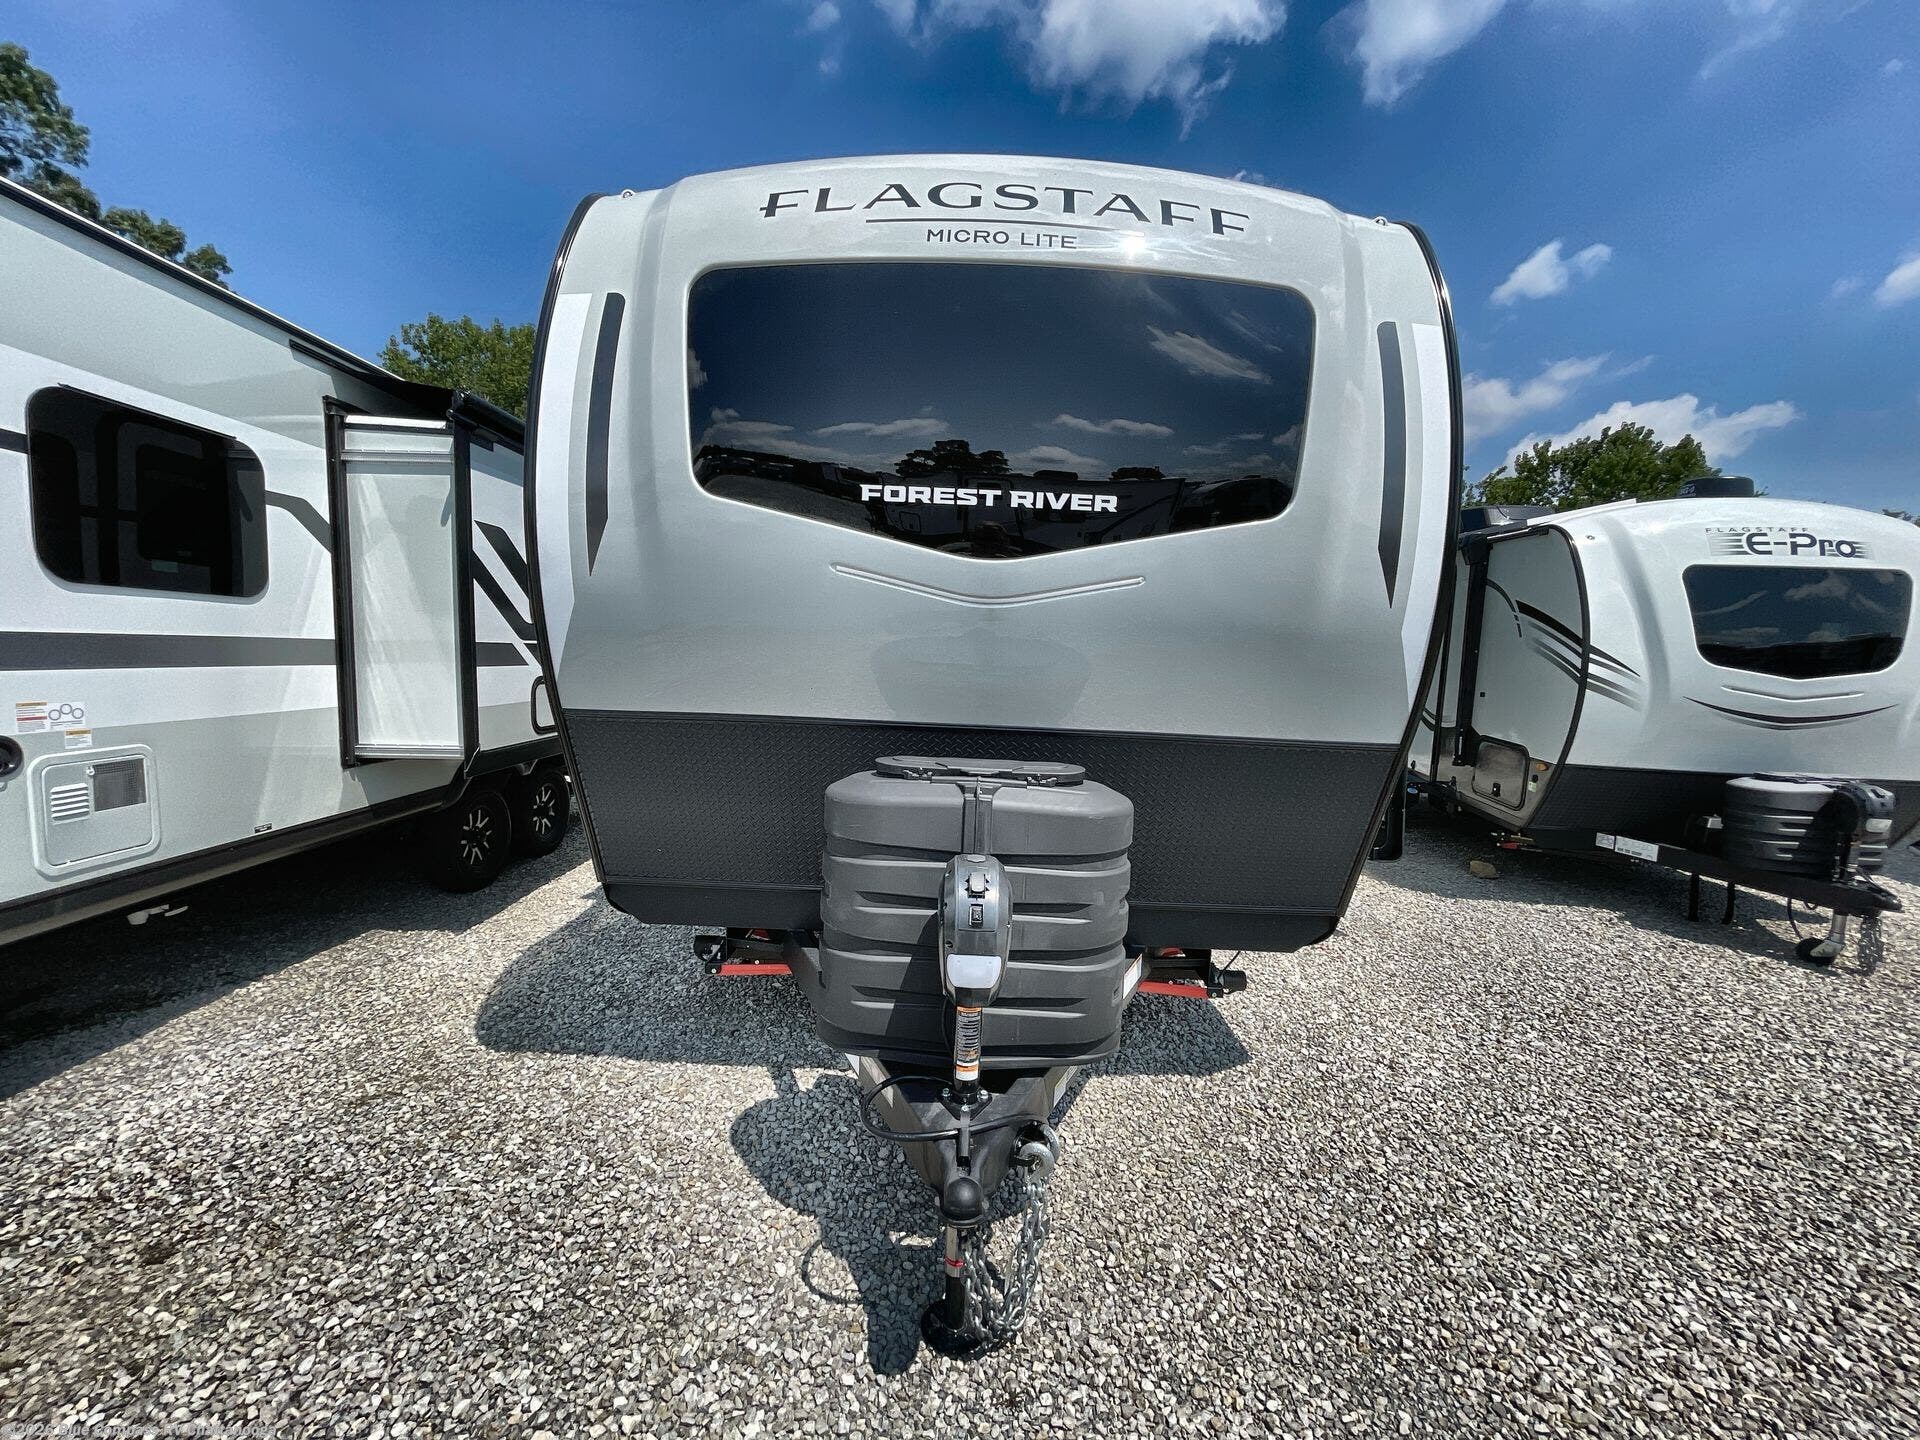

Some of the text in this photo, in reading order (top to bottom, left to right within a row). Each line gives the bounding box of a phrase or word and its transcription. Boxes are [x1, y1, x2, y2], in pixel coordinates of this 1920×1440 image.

[759, 182, 1250, 236] FLAGSTAFF
[926, 229, 1077, 249] MICRO LITE
[860, 484, 1118, 512] FOREST RIVER
[1746, 532, 1856, 558] E-Pro
